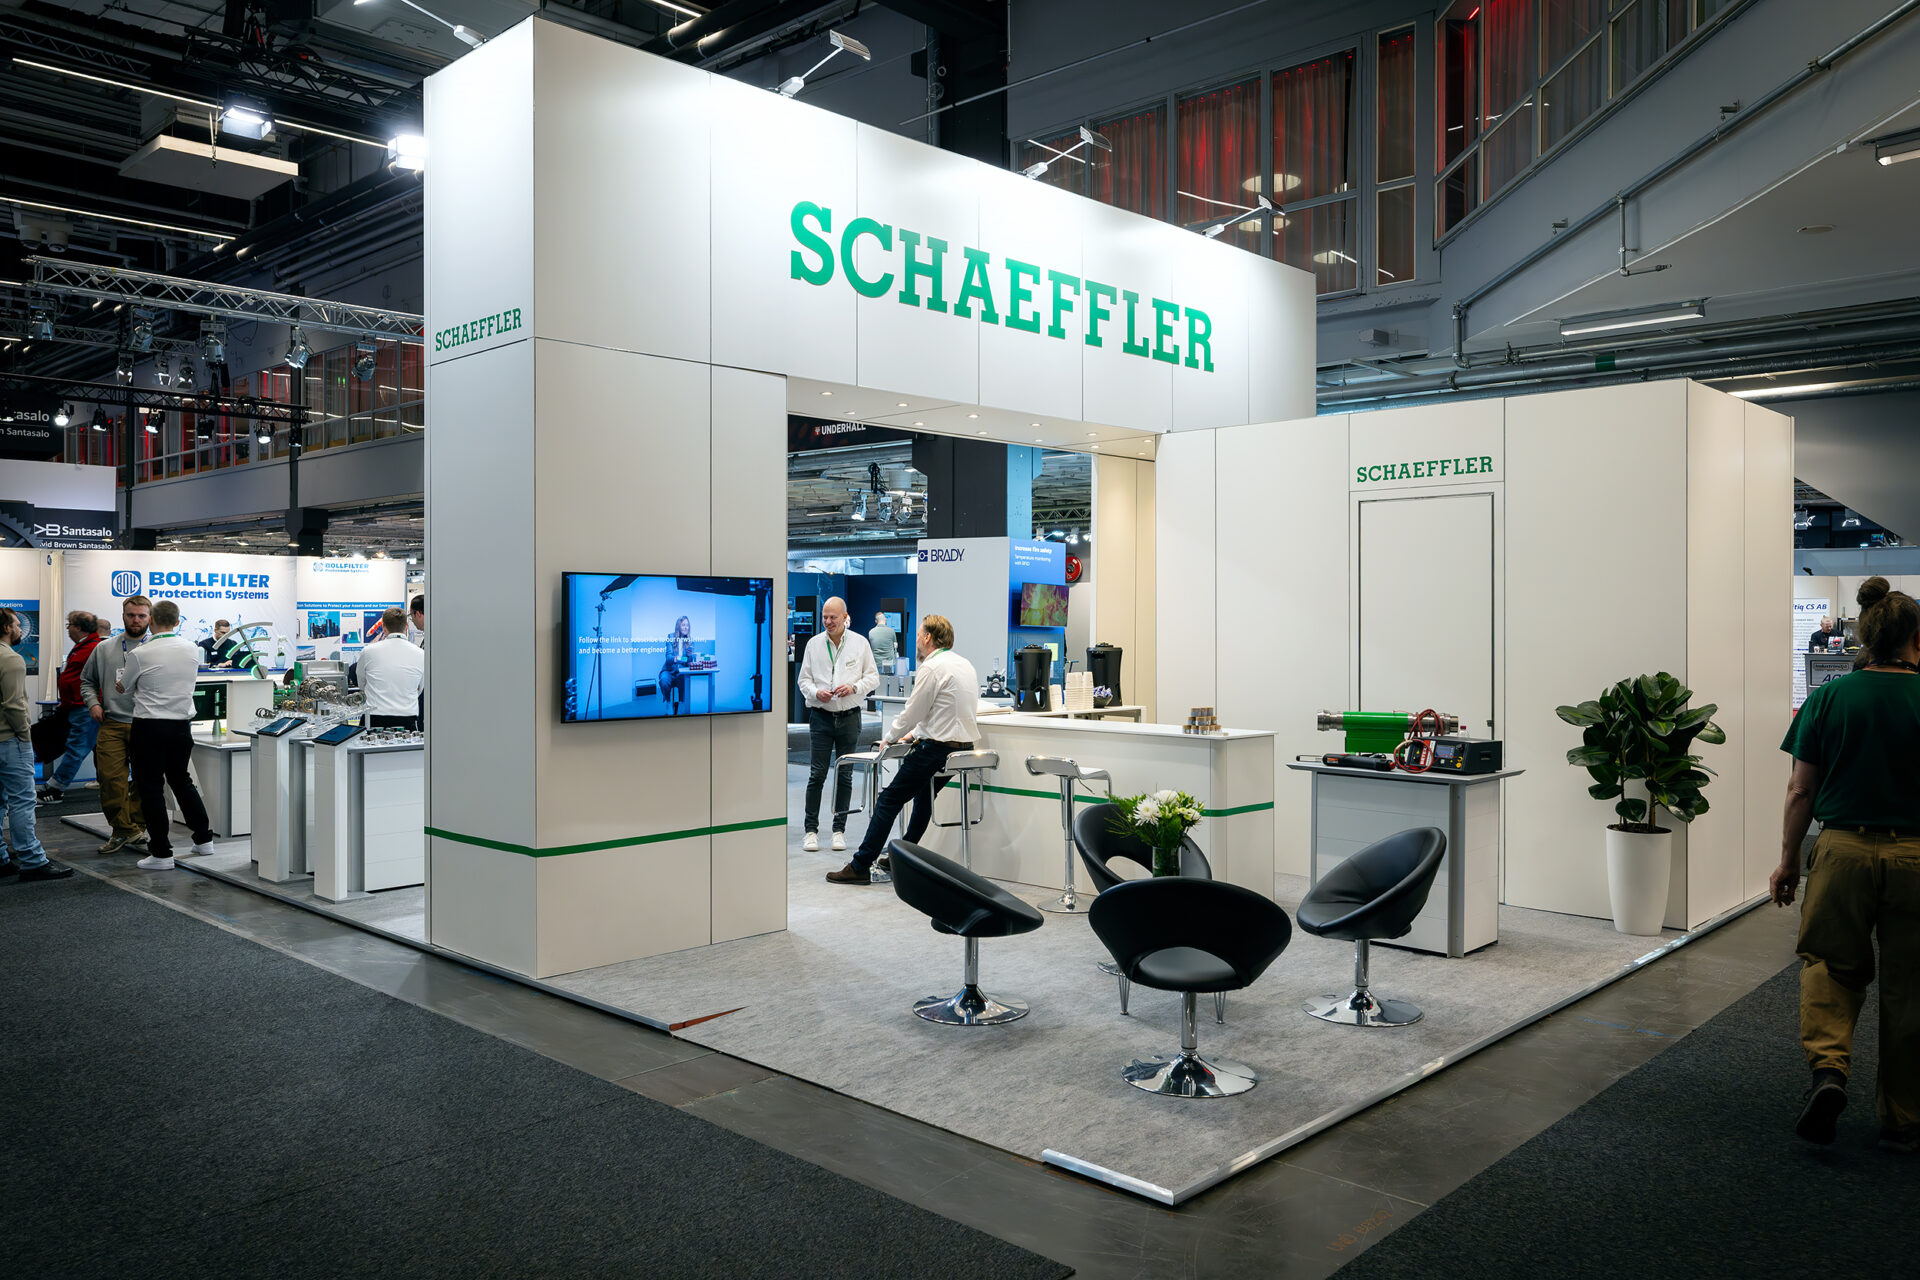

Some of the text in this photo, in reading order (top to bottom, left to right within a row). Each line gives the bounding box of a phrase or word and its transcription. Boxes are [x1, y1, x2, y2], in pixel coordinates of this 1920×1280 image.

[790, 200, 1214, 372] SCHAEFFLER
[435, 307, 522, 352] SCHAEFFLER
[6, 427, 50, 438] Santasalo
[1357, 456, 1493, 483] SCHAEFFLER
[62, 526, 112, 537] Santasalo
[40, 541, 112, 550] vid Brown Santasalo
[930, 548, 965, 562] BRADY
[116, 573, 138, 595] BOLL
[149, 571, 270, 588] BOLLFILTER
[149, 589, 269, 600] Protection Systems
[1793, 603, 1804, 611] tiq
[599, 635, 610, 644] the
[610, 635, 622, 644] link
[623, 635, 630, 643] to
[578, 646, 591, 654] and
[591, 646, 616, 654] become
[621, 645, 639, 654] better
[640, 646, 668, 655] engineer!
